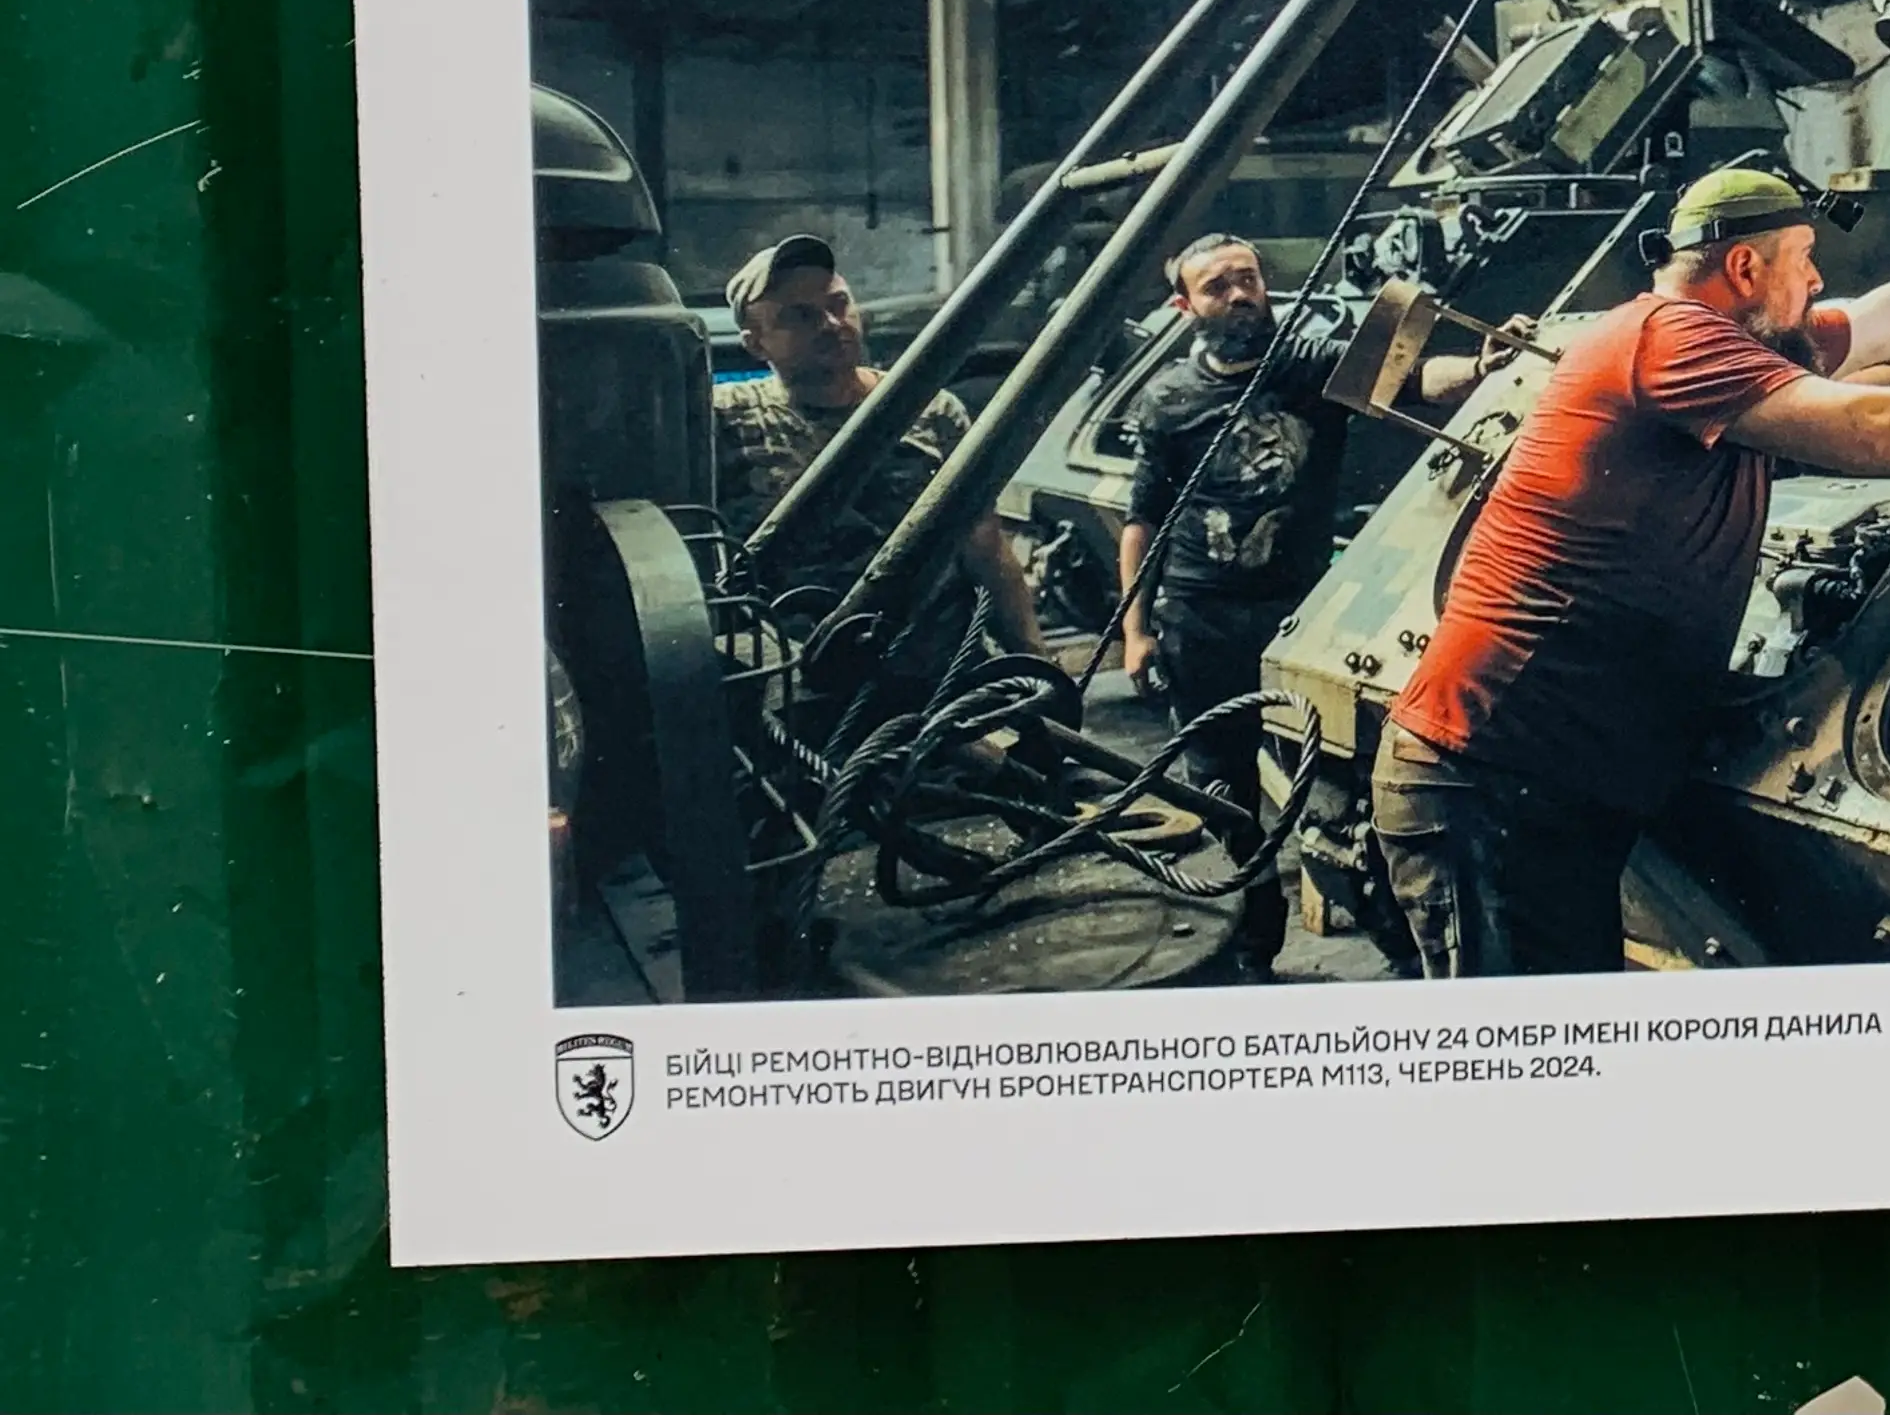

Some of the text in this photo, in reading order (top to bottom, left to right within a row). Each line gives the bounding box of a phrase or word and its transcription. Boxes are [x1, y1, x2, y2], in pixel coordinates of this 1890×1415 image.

[666, 1012, 1883, 1078] БІЙЦІ РЕМОНТНО-ВІДНОВЛЮВАЛЬНОГО БАТАЛЬЙОНУ 24 ОМБР ІМЕНІ КОРОЛЯ ДАНИЛА
[667, 1081, 869, 1109] РЕМОНТУЮТЬ
[875, 1077, 991, 1106] ДВИГУН
[999, 1065, 1314, 1098] БРОНЕТРАНСПОРТЕРА
[1398, 1058, 1524, 1084] ЧЕРВЕНЬ
[1530, 1055, 1601, 1079] 2024.
